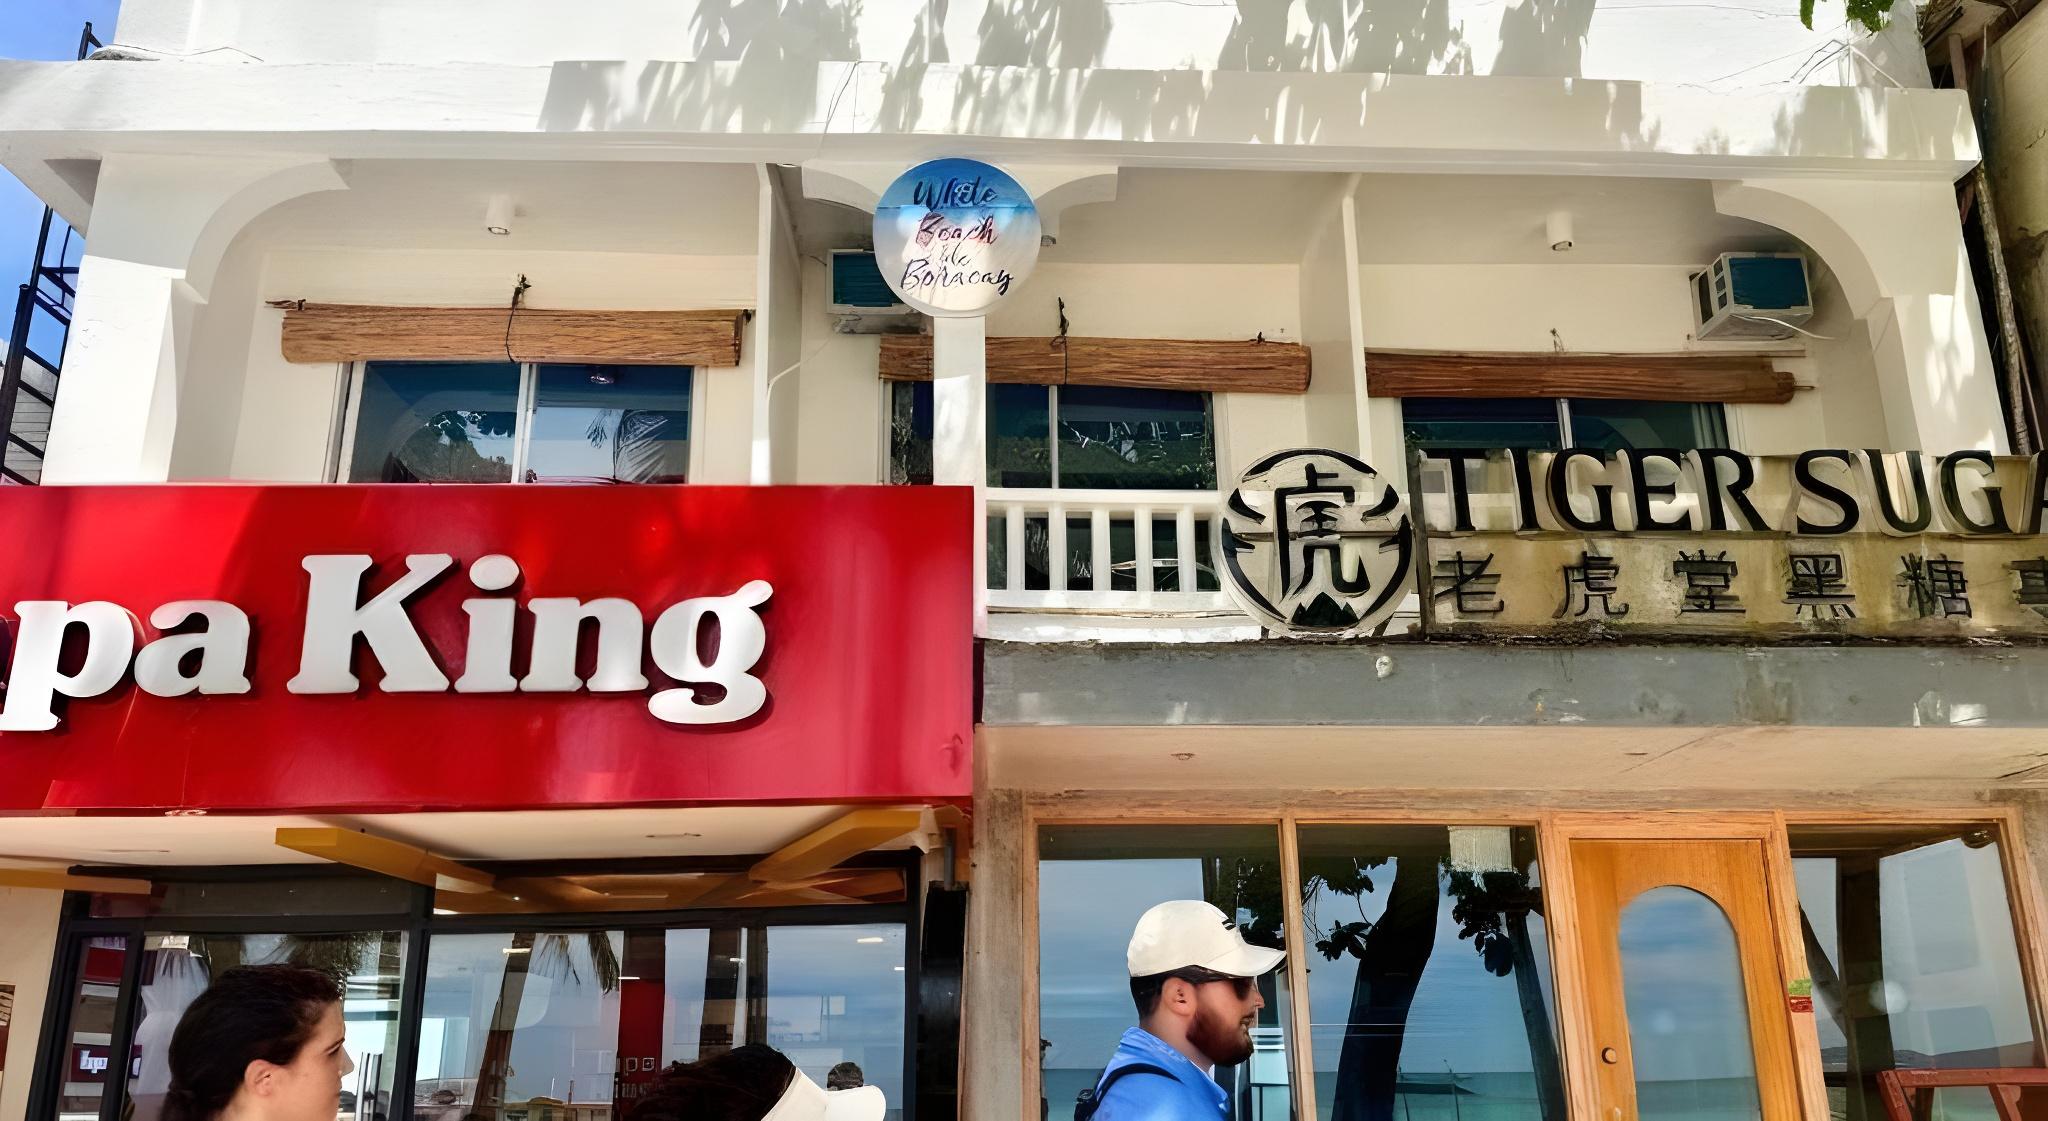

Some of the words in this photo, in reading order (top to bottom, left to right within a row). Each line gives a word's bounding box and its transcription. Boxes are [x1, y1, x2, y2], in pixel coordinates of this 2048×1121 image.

[1418, 447, 1773, 533] TIGER
[0, 600, 252, 732] pa
[286, 552, 774, 725] King
